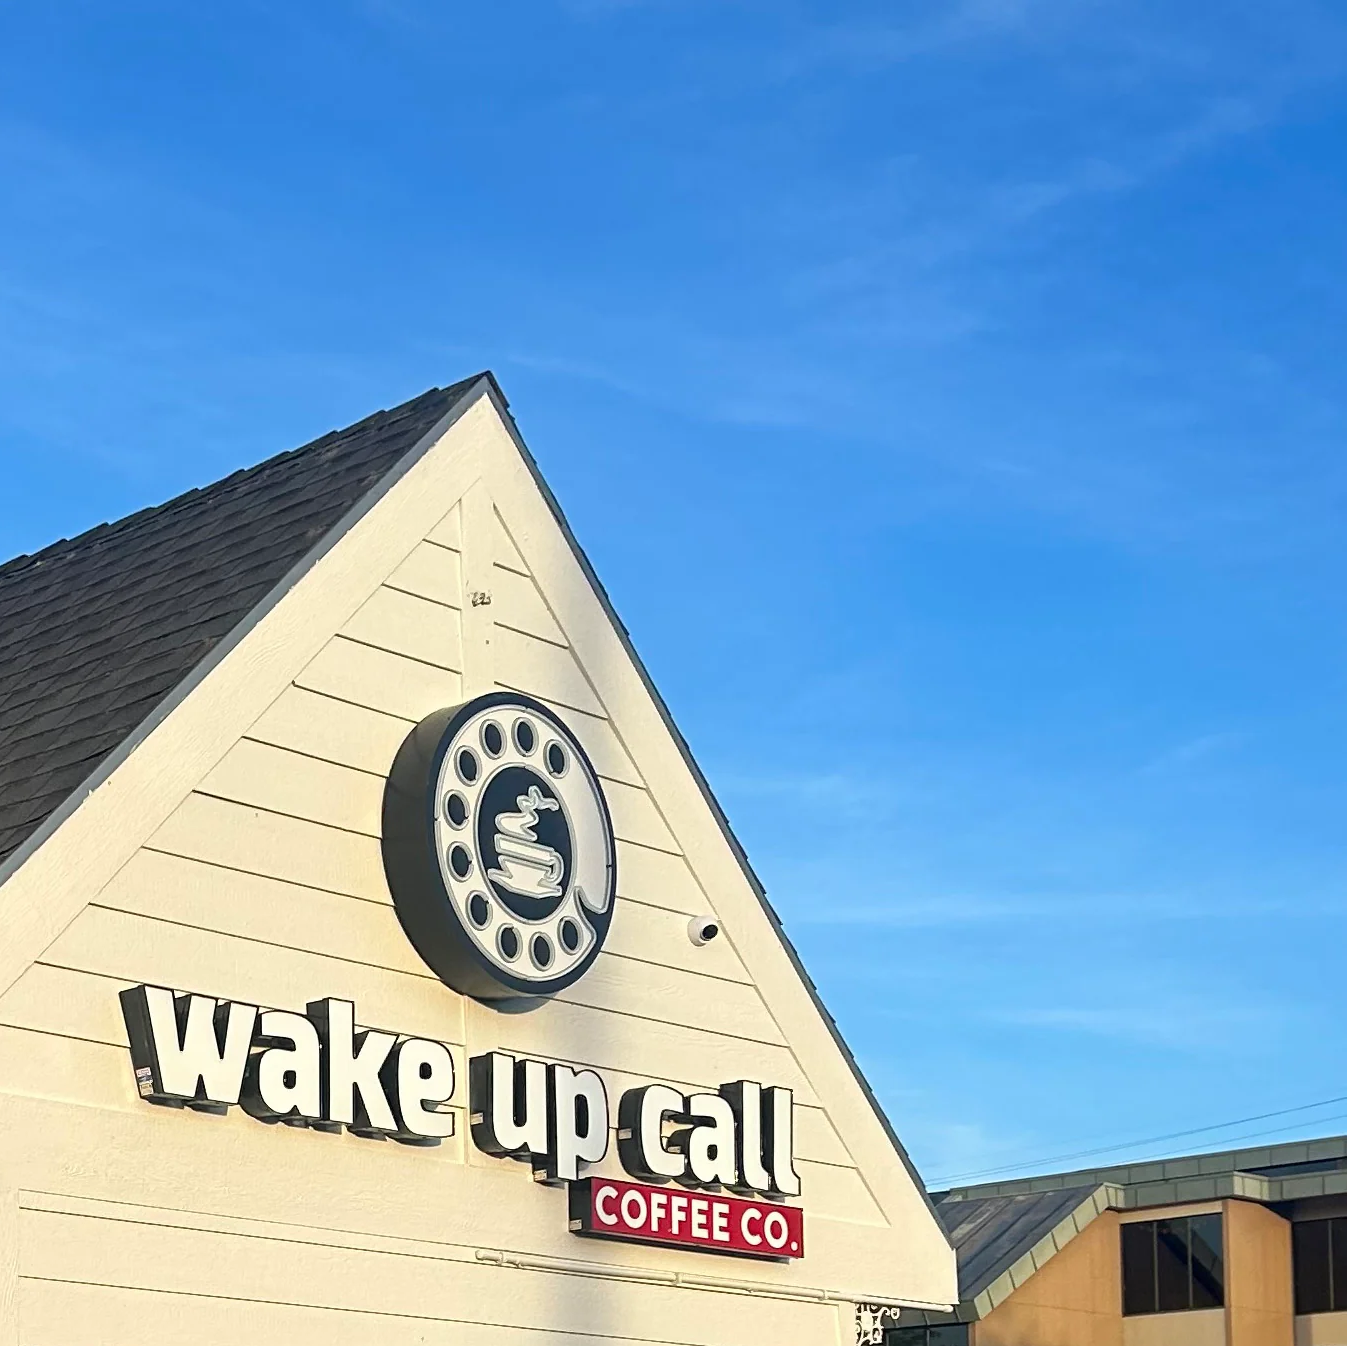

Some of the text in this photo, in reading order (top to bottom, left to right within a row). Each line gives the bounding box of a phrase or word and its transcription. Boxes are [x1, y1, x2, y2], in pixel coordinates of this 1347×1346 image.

[144, 985, 801, 1197] wake up call
[595, 1185, 799, 1252] COFFEE CO.
